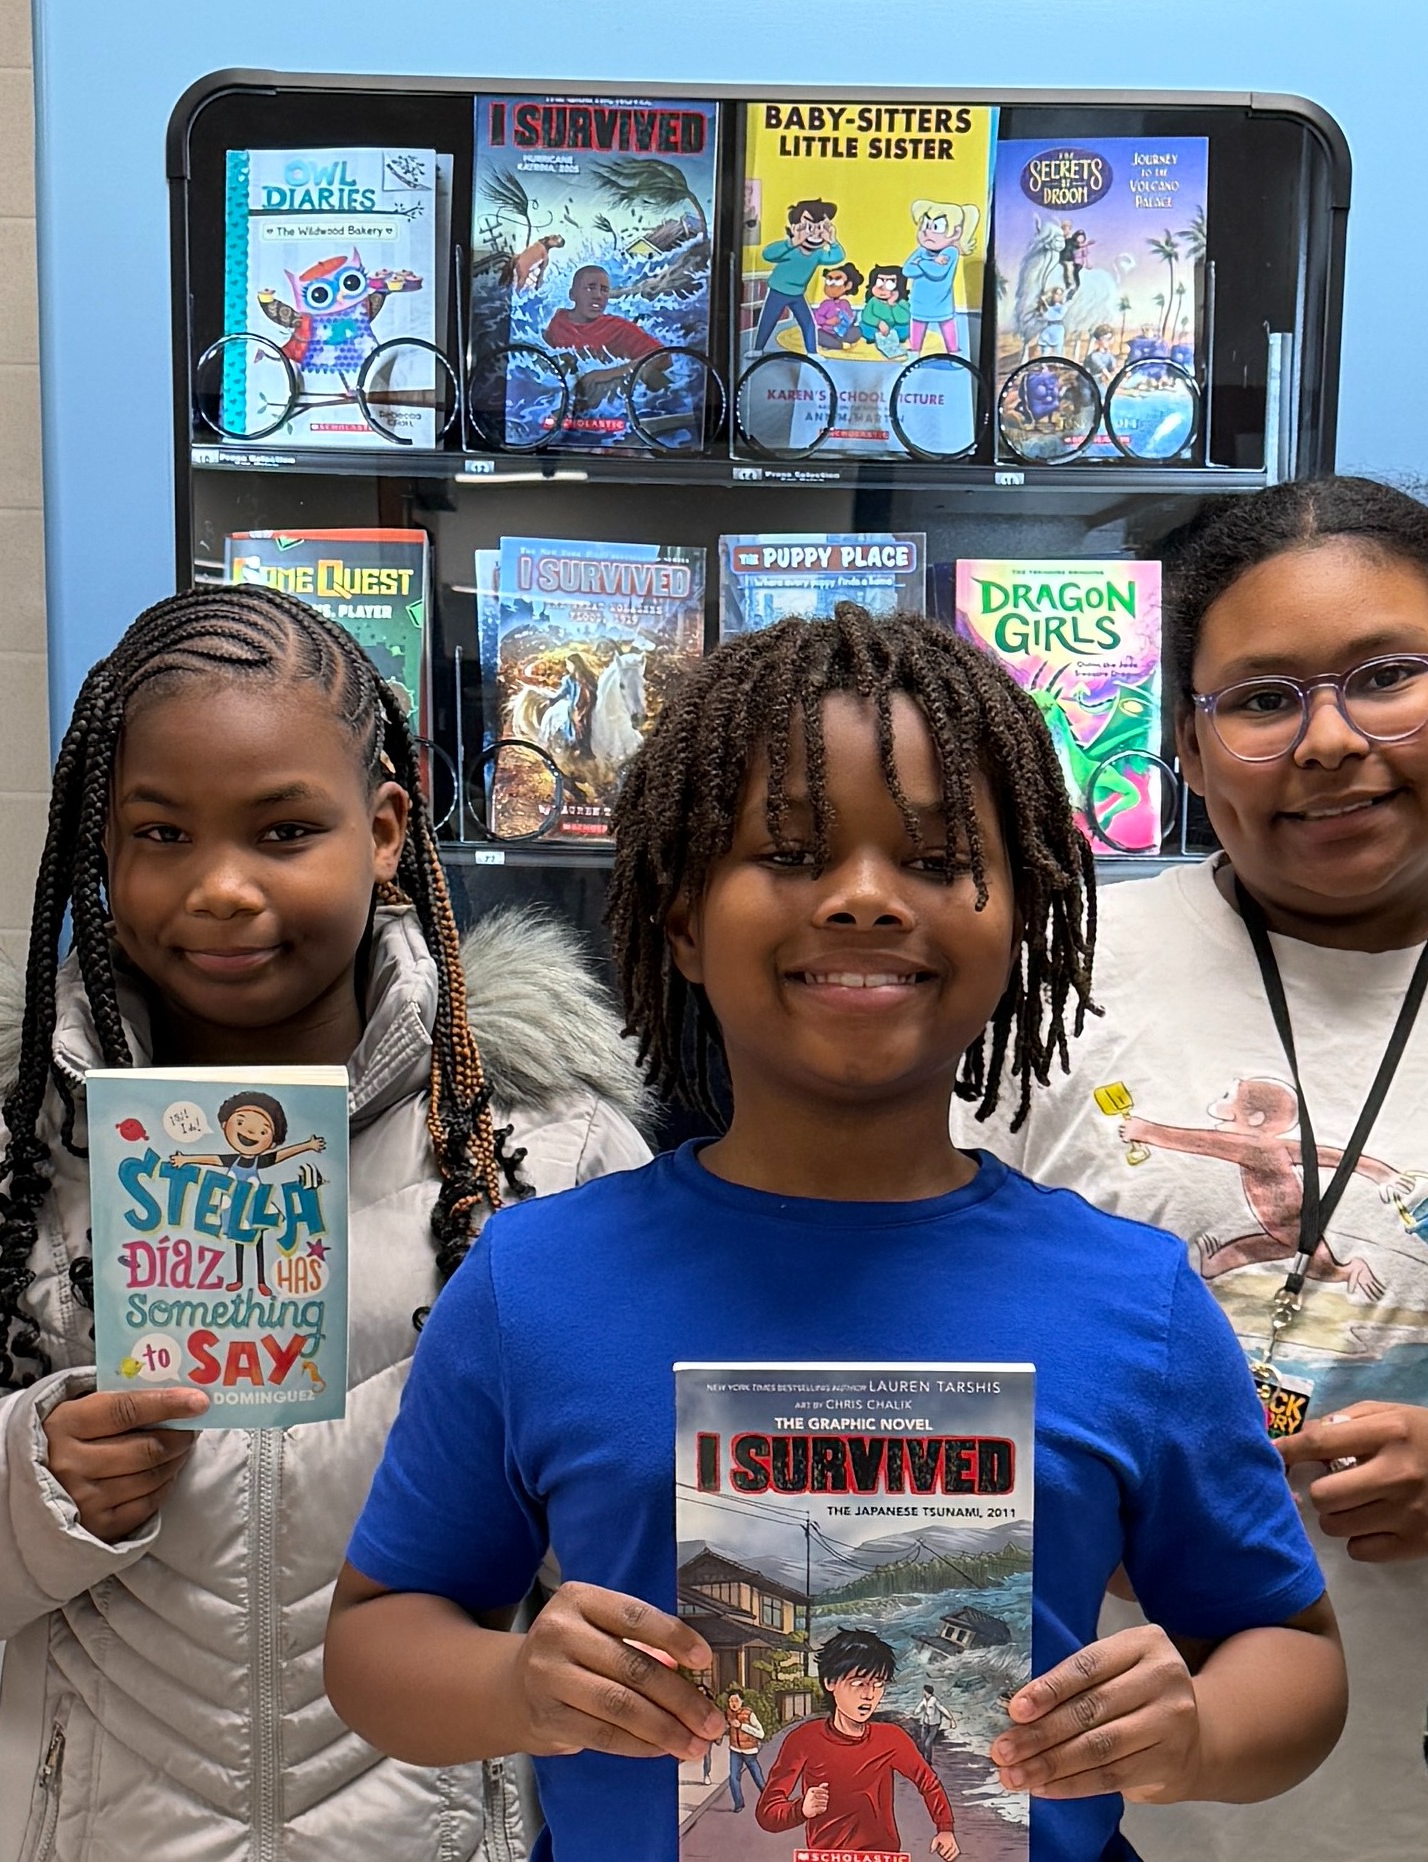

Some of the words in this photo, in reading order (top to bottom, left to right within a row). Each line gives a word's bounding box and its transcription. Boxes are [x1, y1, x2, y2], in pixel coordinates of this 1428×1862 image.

[489, 102, 506, 147] I
[513, 102, 706, 155] SURVIVED
[765, 105, 972, 133] BABY-SITTERS
[780, 136, 858, 158] LITTLE
[868, 138, 955, 160] SISTER
[1132, 152, 1178, 166] JOURNEY
[284, 159, 357, 188] OWL
[1029, 158, 1102, 191] SECRETS
[262, 186, 376, 211] DIARIES
[1044, 187, 1088, 205] DROON
[277, 226, 295, 236] The
[299, 225, 344, 236] Wildwood
[348, 225, 383, 238] Bakery
[767, 389, 826, 401] KAREN'S
[832, 390, 885, 402] CHOOL
[763, 547, 832, 569] PUPPY
[841, 546, 909, 568] PLACE
[318, 560, 414, 600] QUEST
[518, 556, 533, 592] I
[537, 557, 691, 600] SURVIVED
[971, 577, 1136, 619] DRAGON
[338, 604, 392, 619] PLAYER
[995, 612, 1121, 656] GIRLS
[118, 1147, 327, 1252] STELLA
[118, 1235, 225, 1291] Díaz
[277, 1257, 322, 1294] HAS
[126, 1289, 326, 1358] Something
[143, 1344, 171, 1372] to
[187, 1330, 308, 1387] SAY
[213, 1390, 316, 1406] DOMINGUEZ
[869, 1380, 930, 1392] LAUREN
[936, 1380, 1001, 1394] TARSHIS
[825, 1400, 862, 1409] CHRIS
[774, 1417, 804, 1429] THE
[808, 1418, 876, 1430] GRAPHIC
[880, 1418, 933, 1431] NOVEL
[696, 1432, 721, 1494] I
[729, 1432, 1015, 1496] SURVIVED
[827, 1506, 851, 1516] THE
[855, 1506, 919, 1517] JAPANESE
[922, 1506, 983, 1519] TSUNAMI,
[987, 1507, 1016, 1518] 2011
[812, 1853, 907, 1862] SCHOLASTIC
